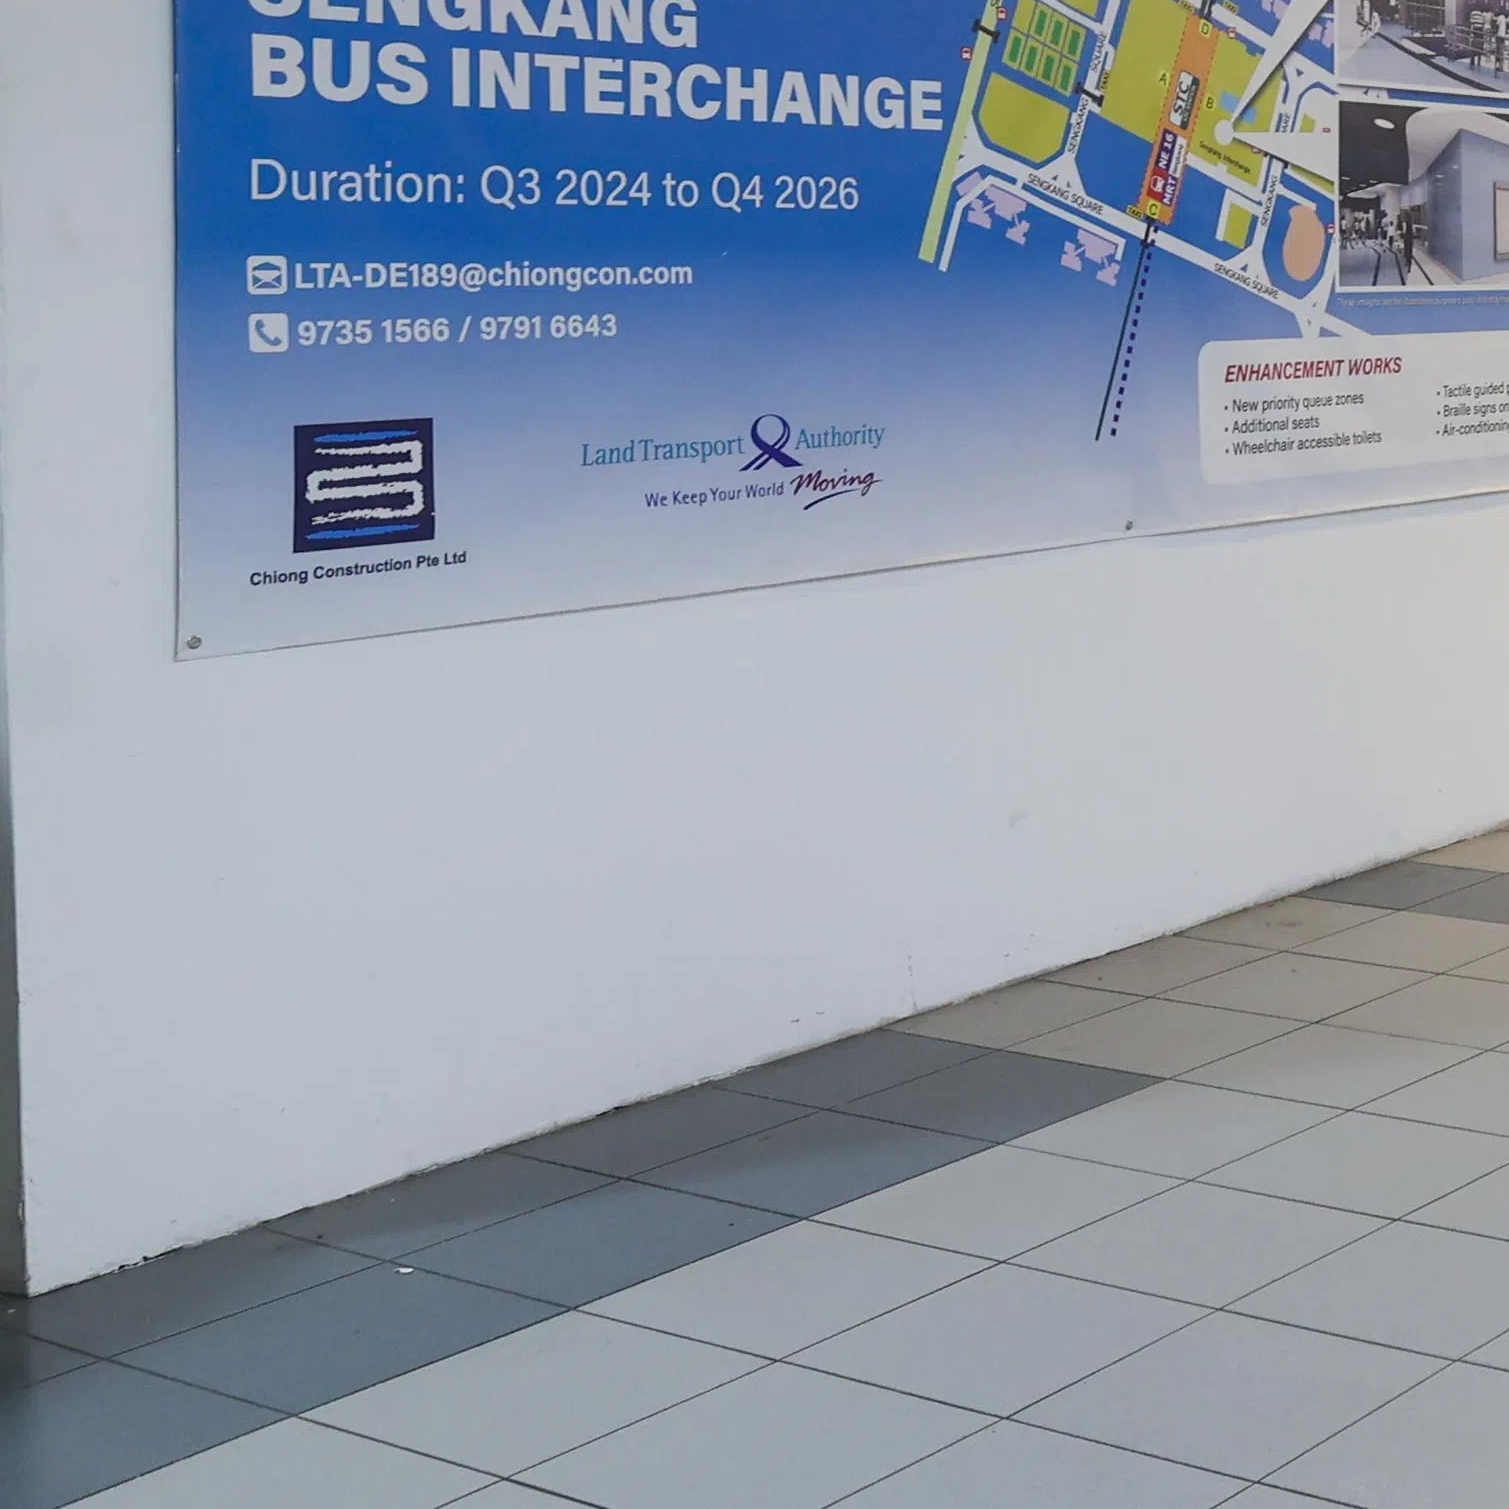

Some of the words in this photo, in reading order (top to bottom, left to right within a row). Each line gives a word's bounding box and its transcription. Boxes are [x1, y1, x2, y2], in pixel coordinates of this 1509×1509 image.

[1201, 22, 1210, 35] D
[251, 32, 429, 107] BUS
[451, 46, 946, 131] INTERCHANGE
[1067, 97, 1089, 154] SENGKANG
[1158, 150, 1171, 168] NE
[249, 157, 465, 206] Duration:
[480, 165, 541, 211] Q3
[555, 169, 652, 207] 2024
[662, 176, 700, 209] to
[711, 174, 764, 215] Q4
[773, 177, 860, 211] 2026
[1028, 173, 1069, 201] SENGKANG
[1070, 193, 1104, 216] SQUARE
[1162, 176, 1178, 205] MRT
[1261, 175, 1278, 228] SENGKANG
[1149, 203, 1158, 216] C
[294, 259, 694, 294] LTA-DE189@chiongcon.com
[1214, 262, 1251, 288] SENGKANG
[1251, 278, 1279, 299] SQUARE
[297, 318, 372, 348] 9735
[380, 316, 451, 346] 1566
[458, 315, 472, 345] /
[480, 315, 544, 343] 9791
[549, 313, 618, 341] 6643
[1225, 359, 1345, 383] ENHANCEMENT
[1348, 356, 1402, 376] WORKS
[1232, 398, 1259, 413] New
[1262, 396, 1300, 413] priority
[1302, 396, 1333, 410] queue
[1335, 393, 1364, 405] zones
[1443, 383, 1472, 398] Tactile
[1474, 381, 1504, 399] guided
[1232, 417, 1289, 434] Additional
[1291, 416, 1320, 431] seats
[1443, 403, 1471, 417] Braille
[1473, 402, 1497, 417] signs
[1498, 402, 1509, 413] on
[580, 437, 635, 469] Land
[637, 431, 746, 468] Transport
[795, 422, 887, 455] Authority
[1232, 438, 1295, 456] Wheelchair
[1297, 432, 1351, 451] accessible
[1352, 429, 1382, 445] toilets
[644, 490, 667, 510] We
[672, 488, 708, 509] Keep
[709, 485, 743, 505] Your
[744, 481, 785, 501] World
[790, 467, 883, 501] Moving
[249, 566, 309, 589] Chiong
[313, 558, 412, 582] Construction
[416, 553, 440, 572] Pte
[442, 549, 467, 567] Ltd
